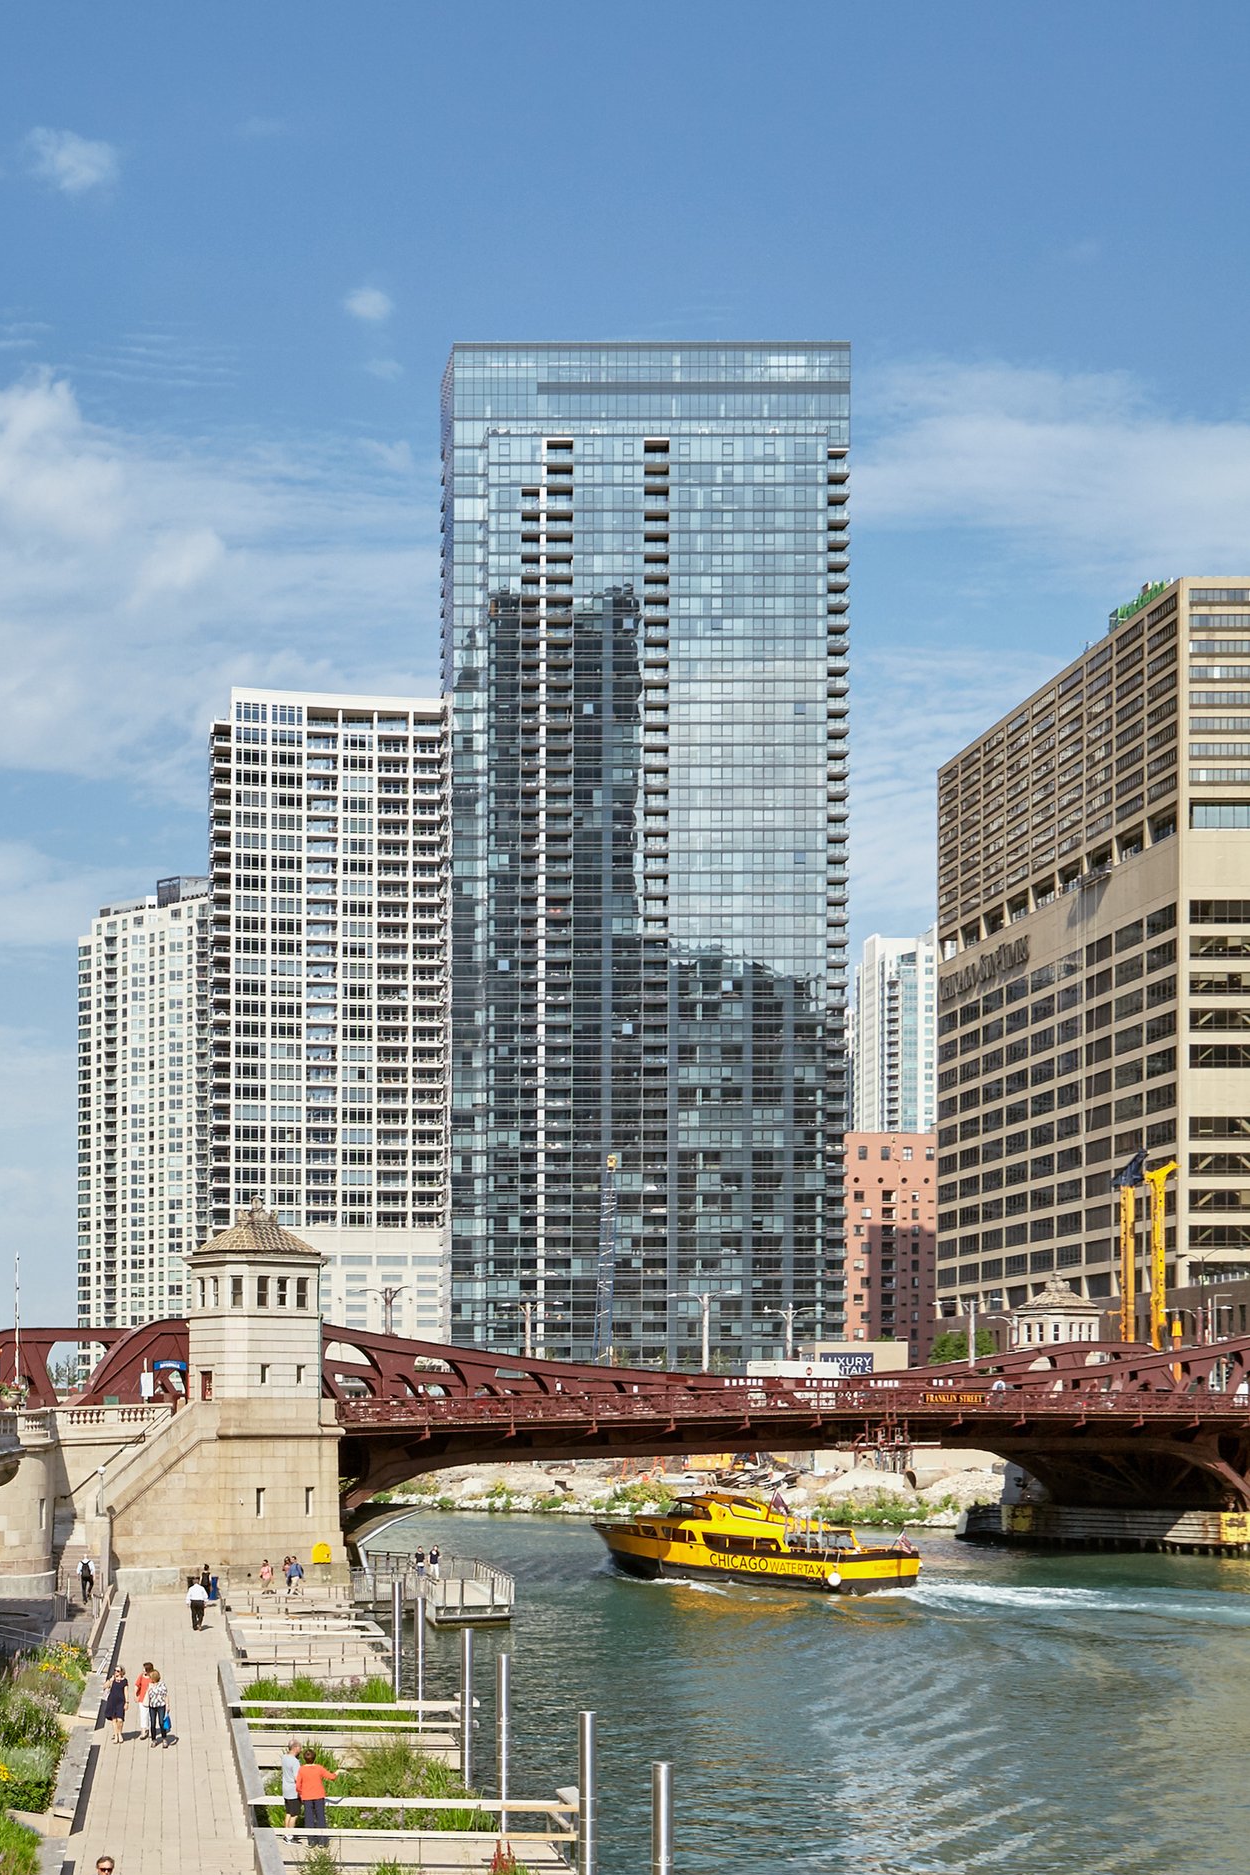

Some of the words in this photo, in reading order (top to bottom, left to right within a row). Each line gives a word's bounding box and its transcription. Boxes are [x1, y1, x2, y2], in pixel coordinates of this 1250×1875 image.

[839, 1365, 872, 1376] NTALS
[926, 1394, 957, 1403] FRANKLIN
[959, 1394, 982, 1403] STREET
[710, 1553, 768, 1571] CHICAGO
